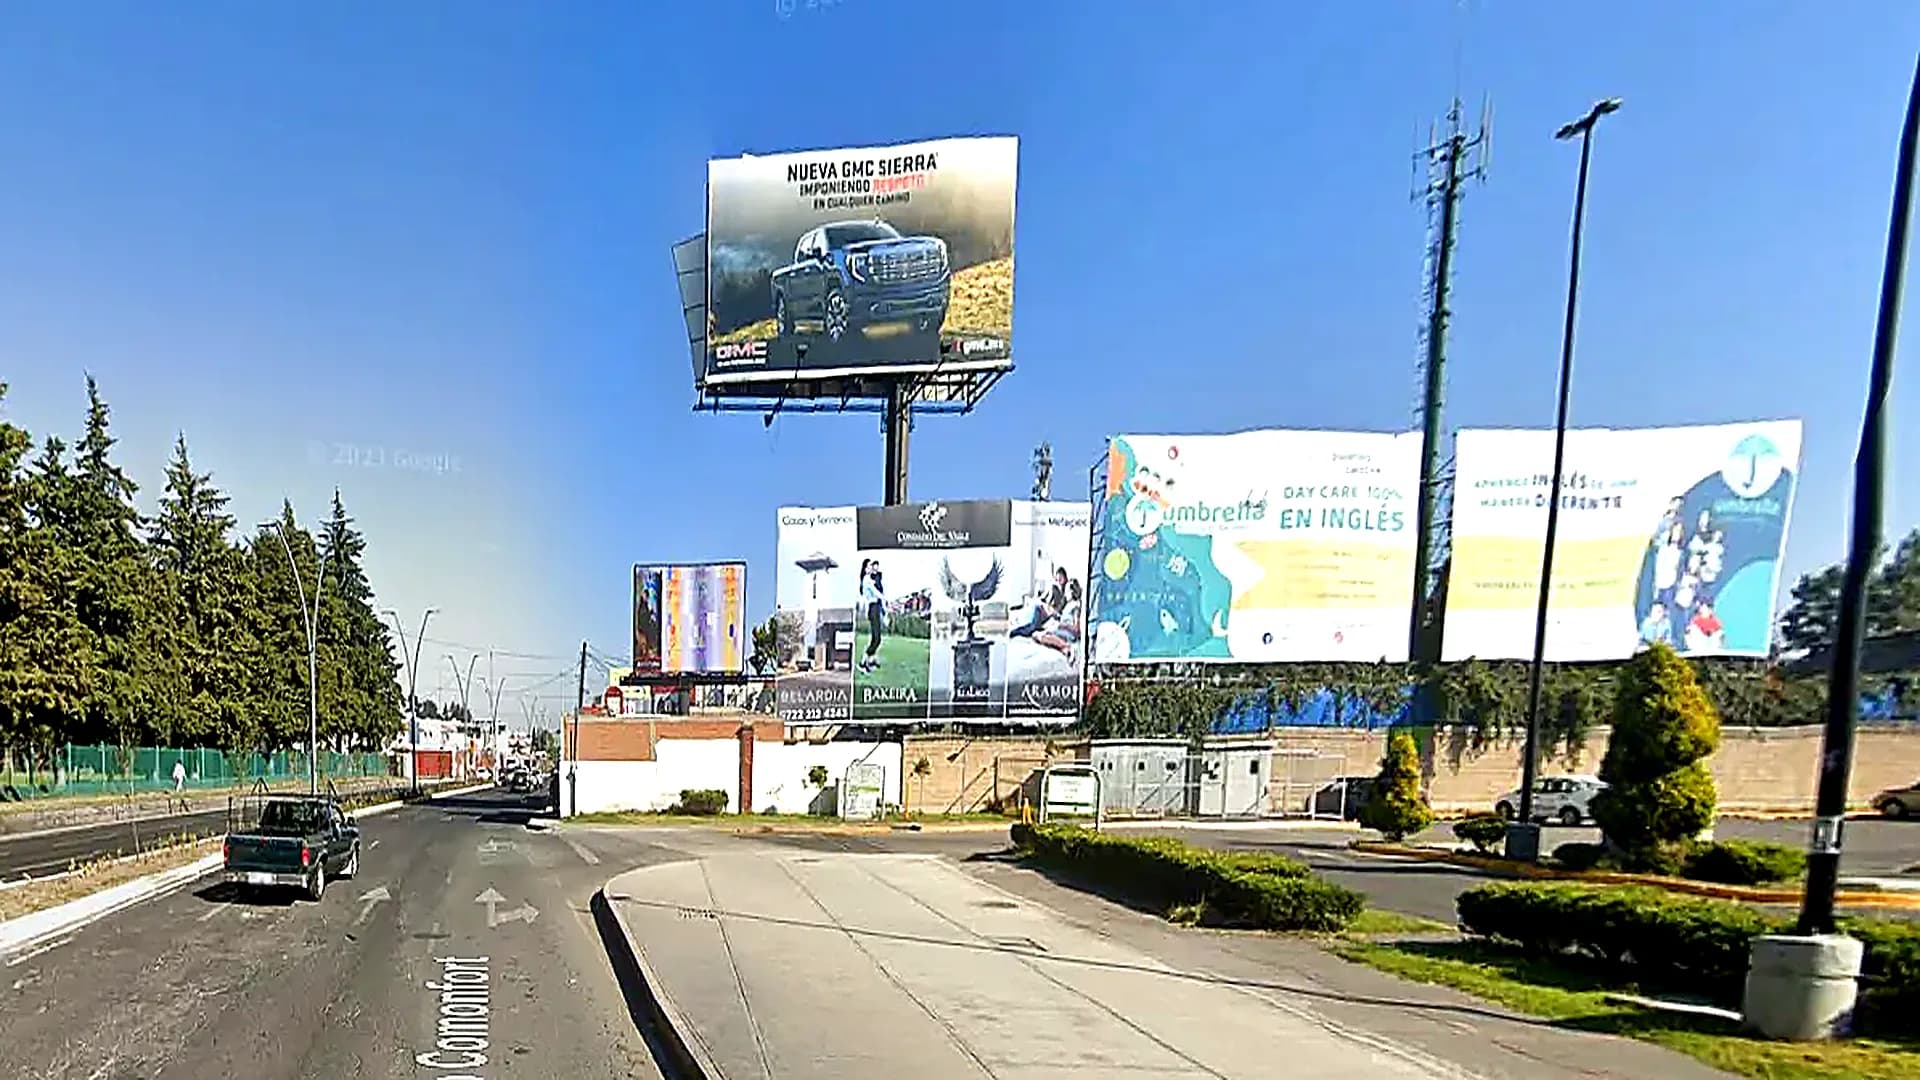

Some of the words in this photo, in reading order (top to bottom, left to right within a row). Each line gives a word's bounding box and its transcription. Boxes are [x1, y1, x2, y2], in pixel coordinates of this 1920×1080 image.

[787, 161, 838, 182] NUEVA
[842, 159, 875, 178] GMC
[878, 152, 938, 176] SIERRA
[799, 179, 870, 196] IMPONIENDO
[1283, 485, 1315, 499] DAY
[1319, 485, 1359, 499] CARE
[1162, 498, 1266, 522] umbrella
[1280, 508, 1312, 529] EN
[1321, 503, 1405, 532] INGLÉS
